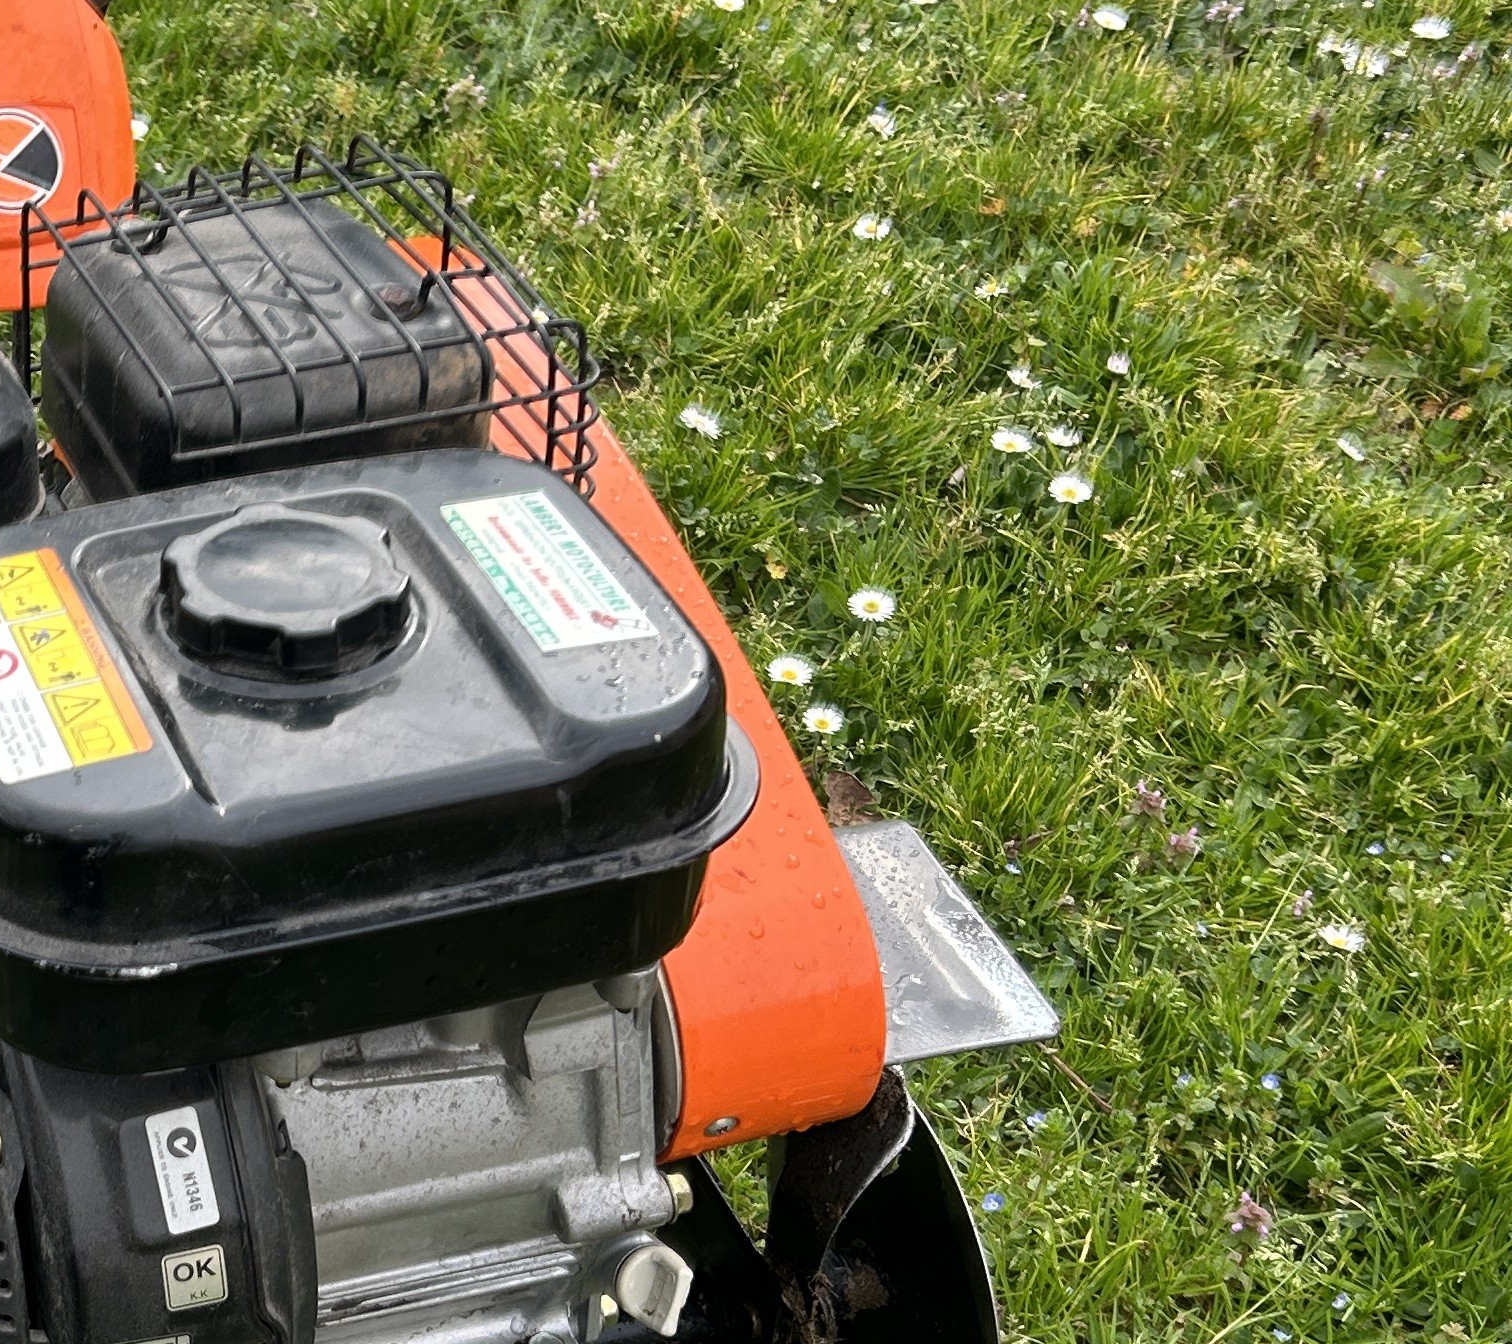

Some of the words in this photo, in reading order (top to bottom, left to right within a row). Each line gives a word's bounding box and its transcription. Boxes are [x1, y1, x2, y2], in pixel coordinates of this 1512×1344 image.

[517, 493, 569, 537] LAMBERT
[556, 539, 633, 613] MOTOCULTURE
[182, 1171, 204, 1213] N1346
[172, 1256, 217, 1284] OK
